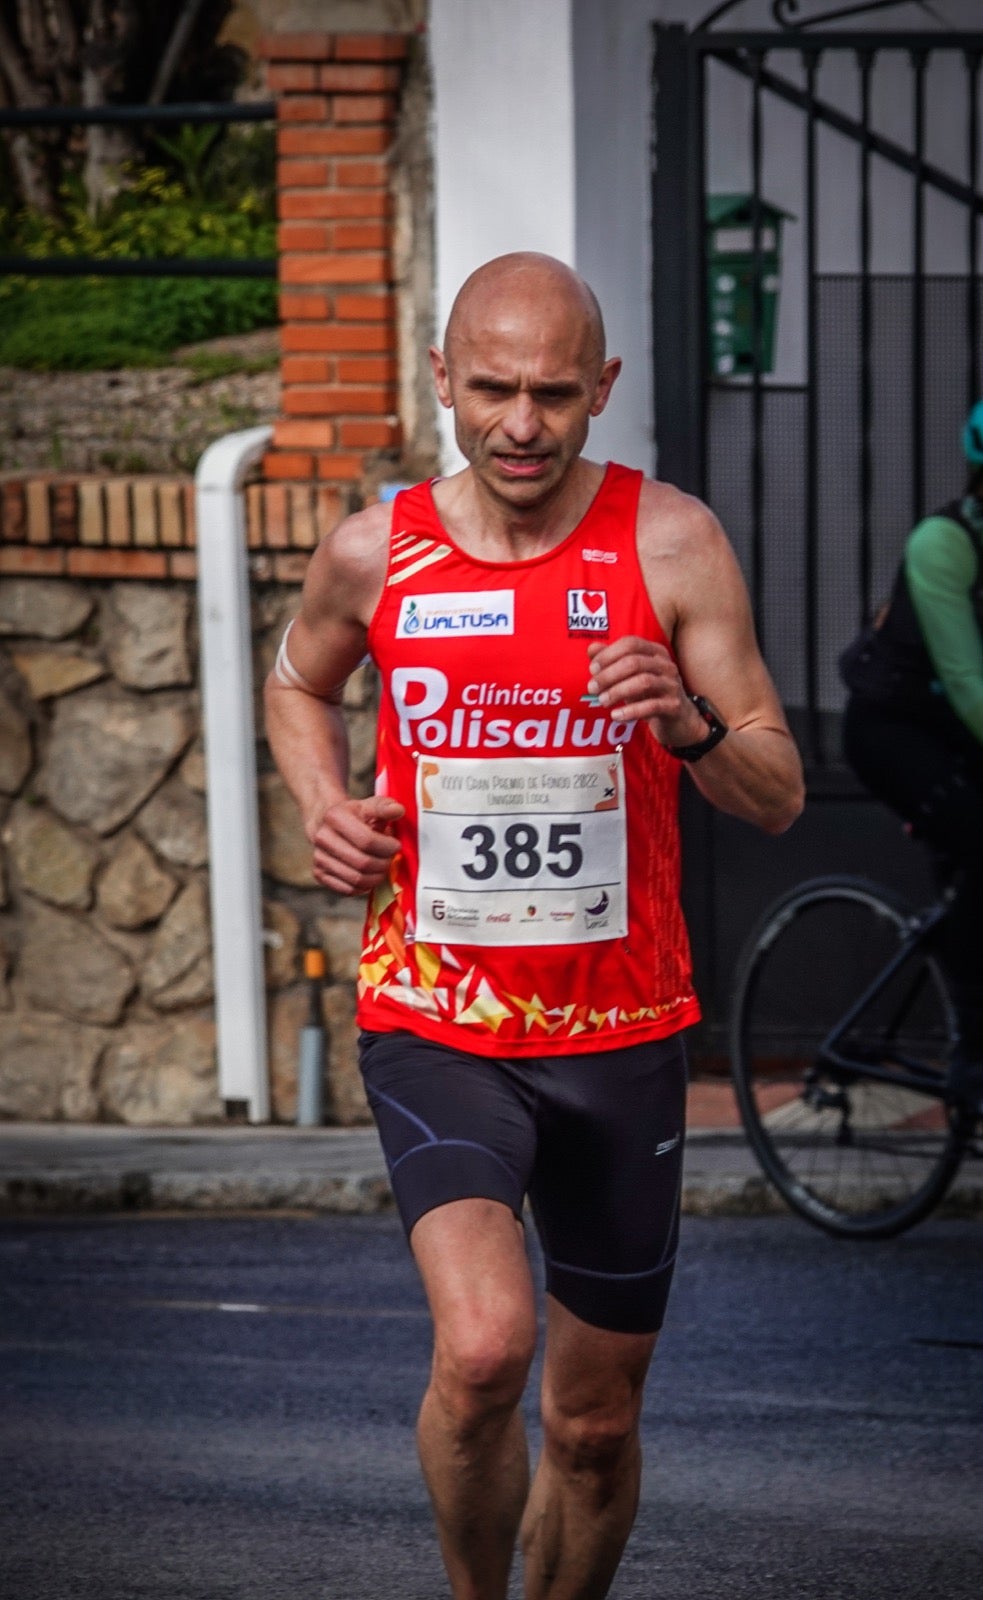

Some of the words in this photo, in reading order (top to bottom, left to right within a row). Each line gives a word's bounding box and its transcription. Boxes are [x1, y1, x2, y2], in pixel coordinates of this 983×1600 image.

[571, 593, 579, 614] I
[569, 616, 609, 628] MOVE
[461, 683, 563, 706] Clínicas
[461, 823, 583, 880] 385
